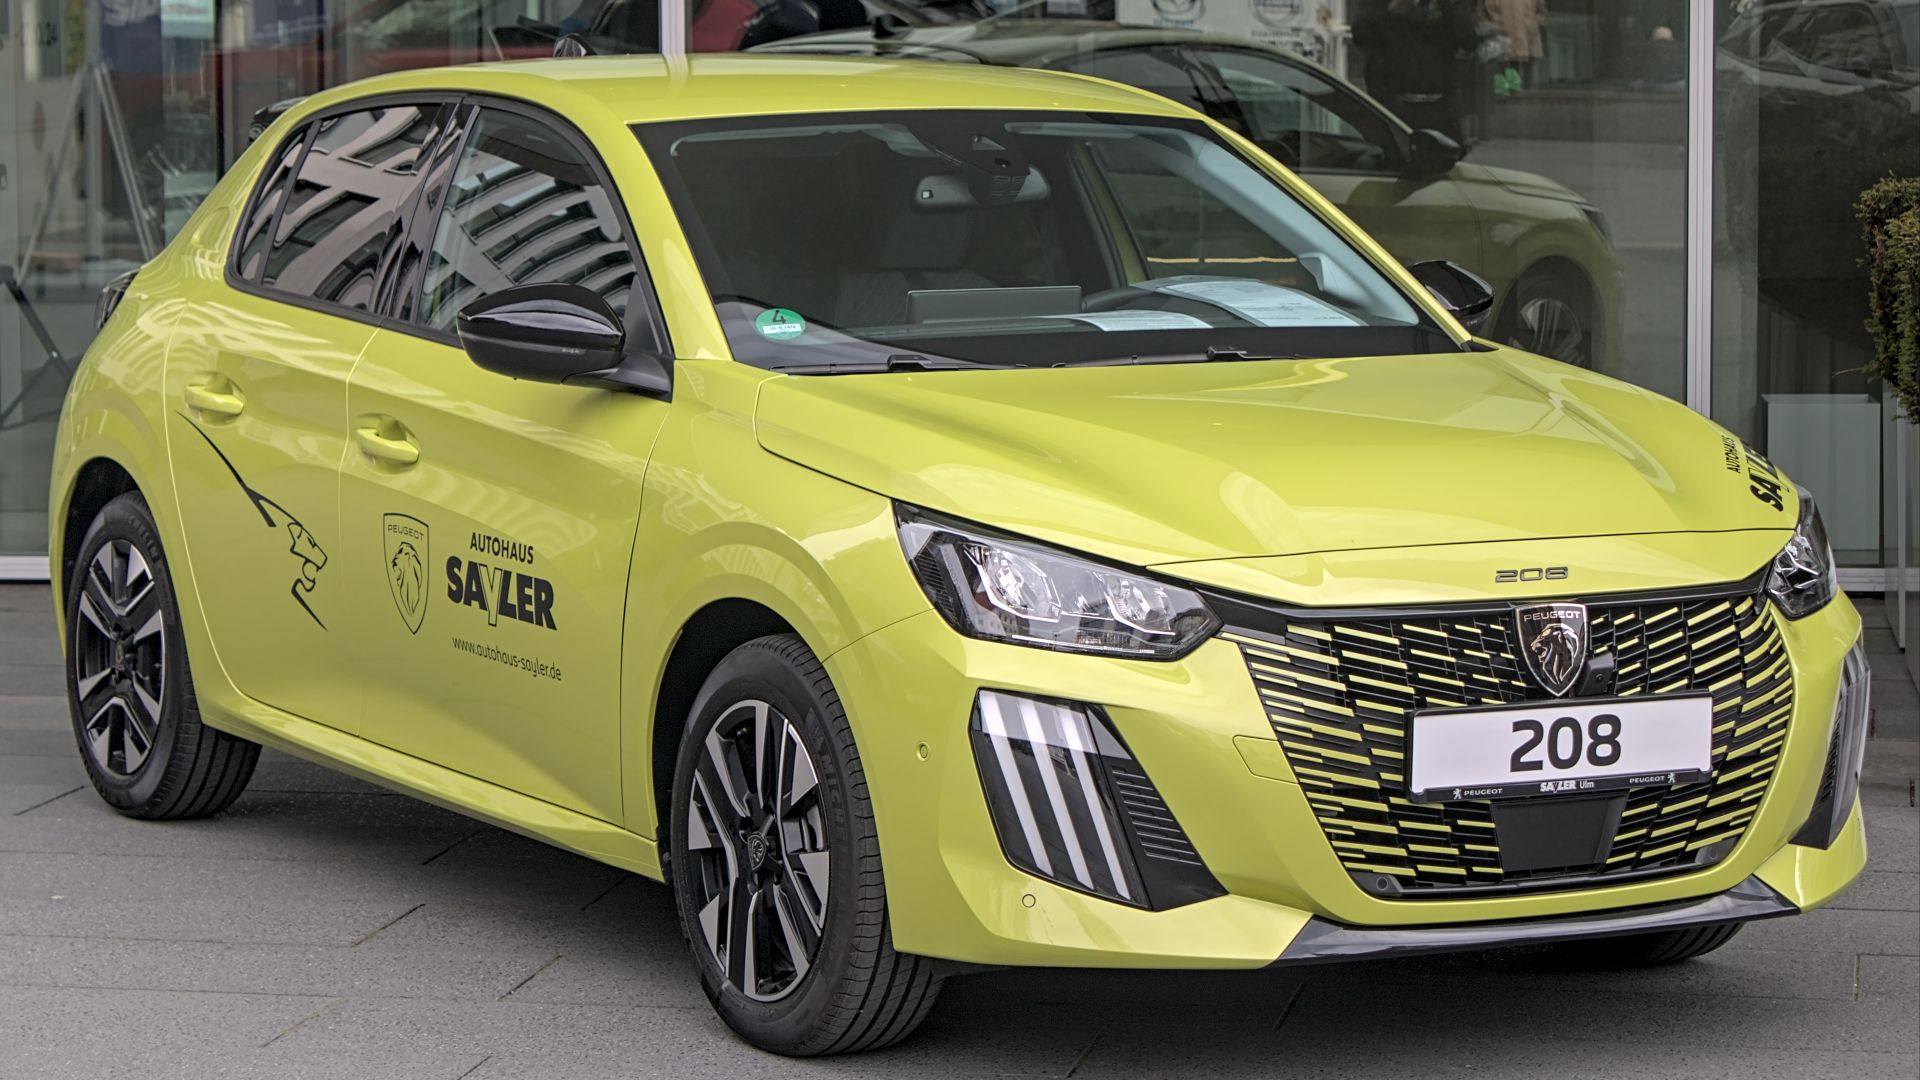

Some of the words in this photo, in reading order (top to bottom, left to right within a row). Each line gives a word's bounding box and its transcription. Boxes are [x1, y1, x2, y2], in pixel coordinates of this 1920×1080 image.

[772, 309, 788, 325] 4
[387, 524, 425, 541] PEUGEOT
[469, 532, 534, 565] AUTOHAUS
[1495, 566, 1569, 583] 208
[445, 555, 558, 631] SAYLER
[1523, 610, 1581, 622] PEUGEOT
[452, 637, 562, 681] www.autohaus-sayler.de
[1510, 713, 1622, 773] 208
[1540, 779, 1577, 794] SAYLER
[1579, 780, 1595, 789] Ulm
[1629, 775, 1665, 784] PEUGEOT
[1463, 788, 1503, 797] PEUGEOT
